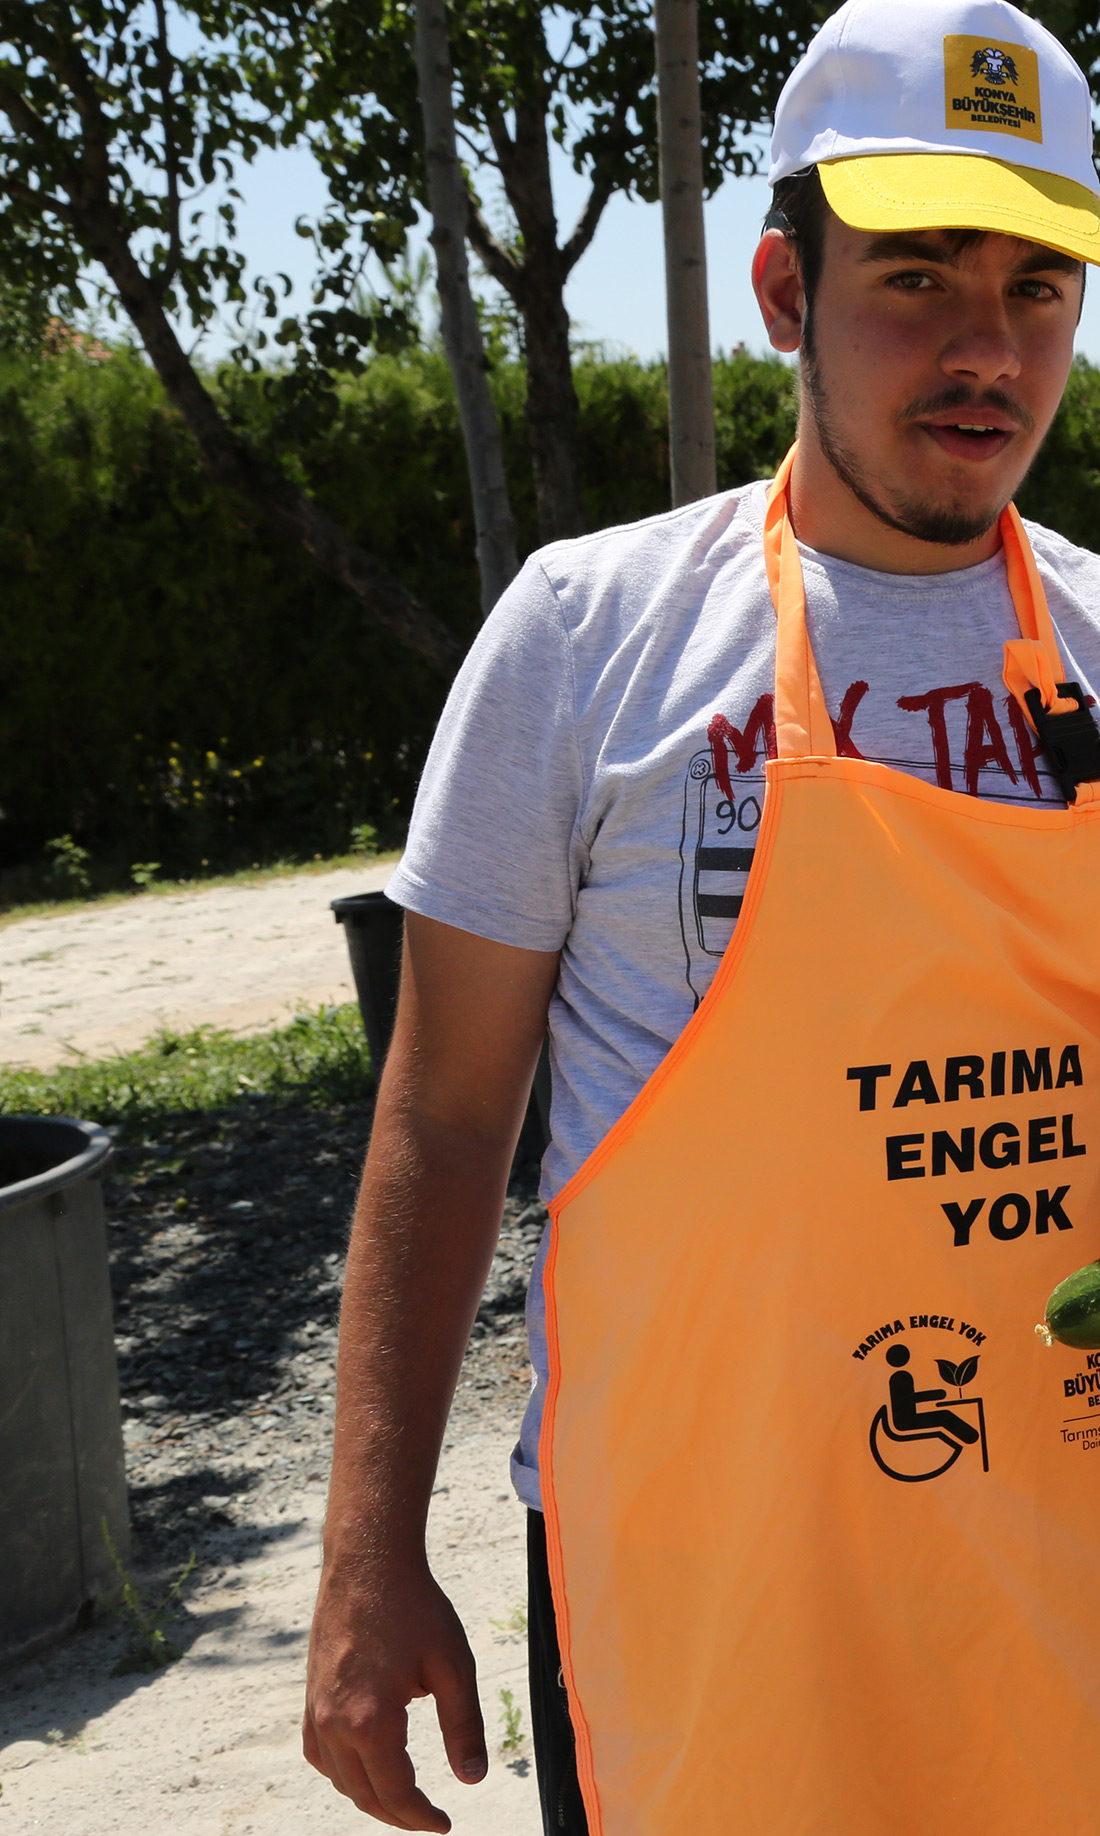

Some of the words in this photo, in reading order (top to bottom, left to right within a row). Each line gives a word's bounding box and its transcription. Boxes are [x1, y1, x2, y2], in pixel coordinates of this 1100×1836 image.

[952, 96, 1036, 123] BÜYÜKŞEHİR
[974, 87, 1017, 103] KONYA
[971, 114, 1021, 128] BELEDİYESİ
[716, 796, 761, 834] 90
[847, 1045, 1083, 1111] TARIMA
[886, 1114, 1086, 1181] ENGEL
[940, 1185, 1074, 1247] YOK
[852, 1319, 905, 1361] TARIMA
[909, 1315, 955, 1331] ENGEL
[958, 1322, 987, 1347] YOK
